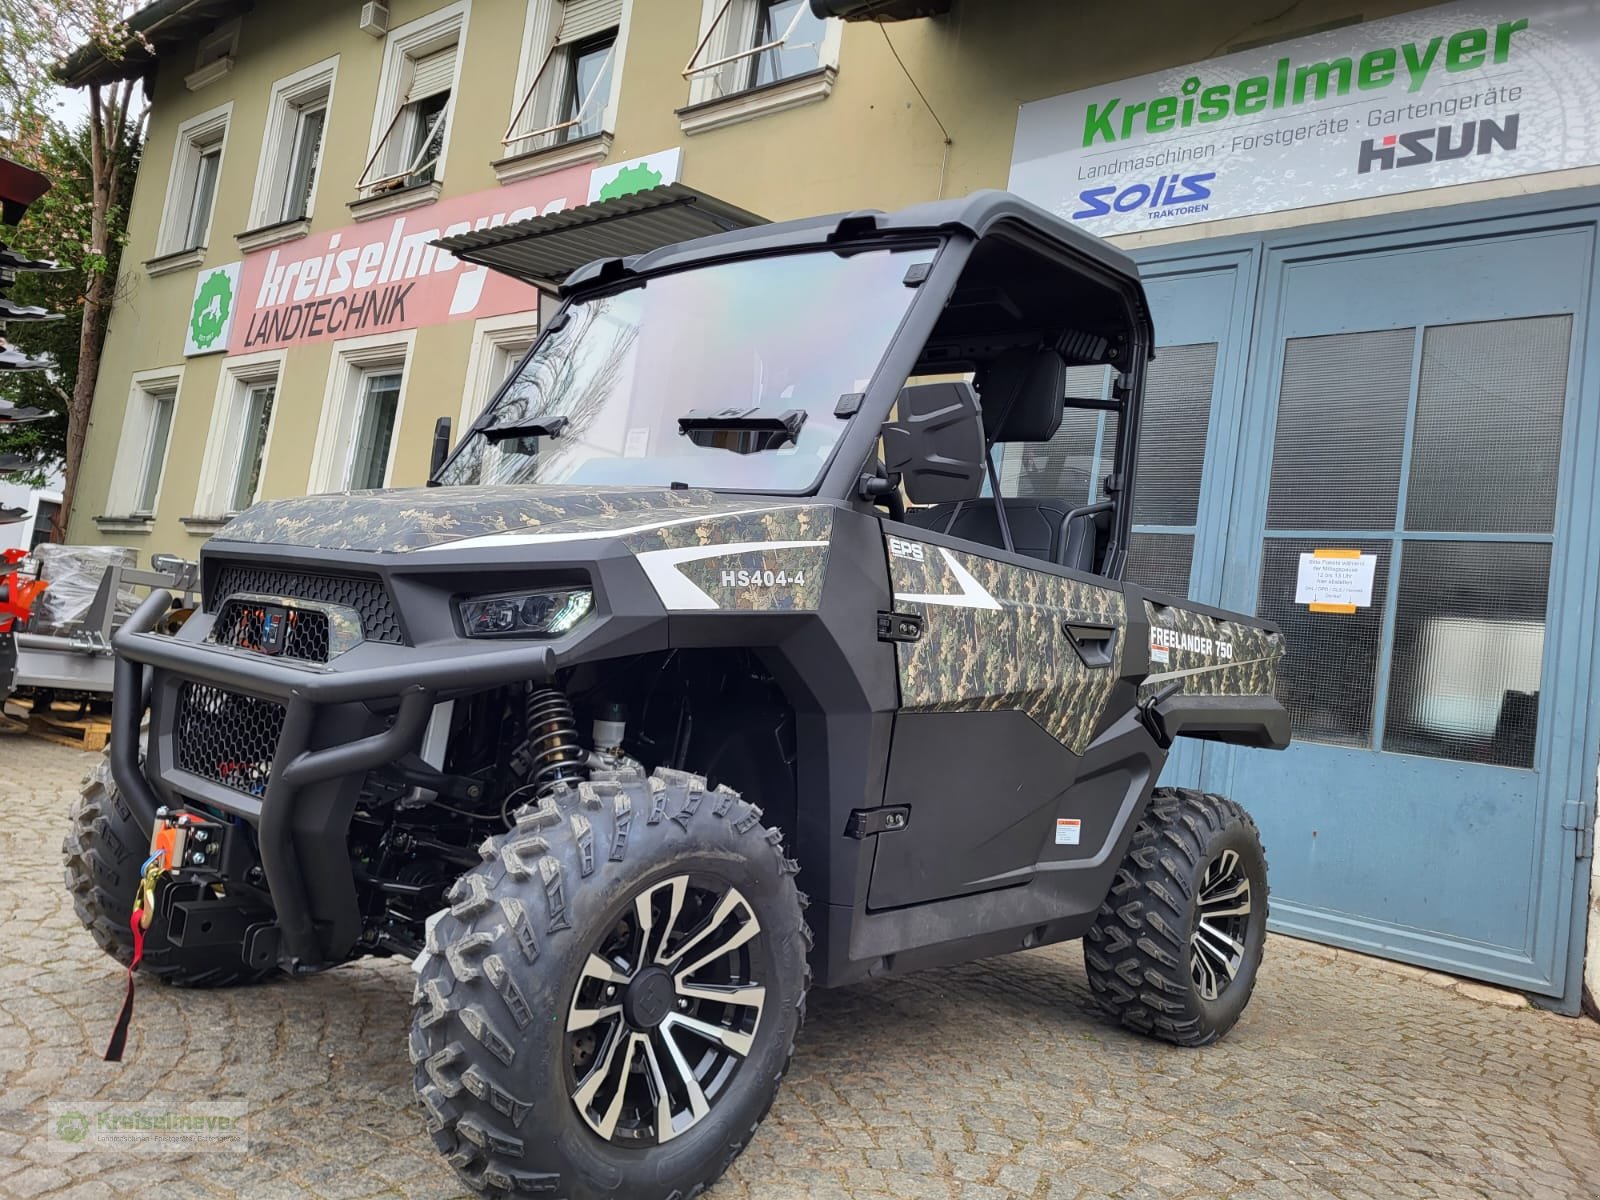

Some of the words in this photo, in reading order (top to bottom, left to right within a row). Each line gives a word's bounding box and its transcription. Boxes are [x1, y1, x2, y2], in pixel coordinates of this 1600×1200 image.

[1082, 18, 1528, 148] Kreiselmeyer
[1078, 142, 1216, 181] Landmaschinen
[1231, 117, 1349, 153] Forstgeräte
[1367, 86, 1523, 127] Gartengeräte
[1147, 203, 1209, 220] TRAKTOREN
[244, 282, 417, 348] LANDTECHNIK
[889, 538, 924, 559] EPS
[721, 569, 805, 588] HS404-4
[1150, 626, 1213, 656] FREELANDER
[1215, 641, 1233, 659] 750
